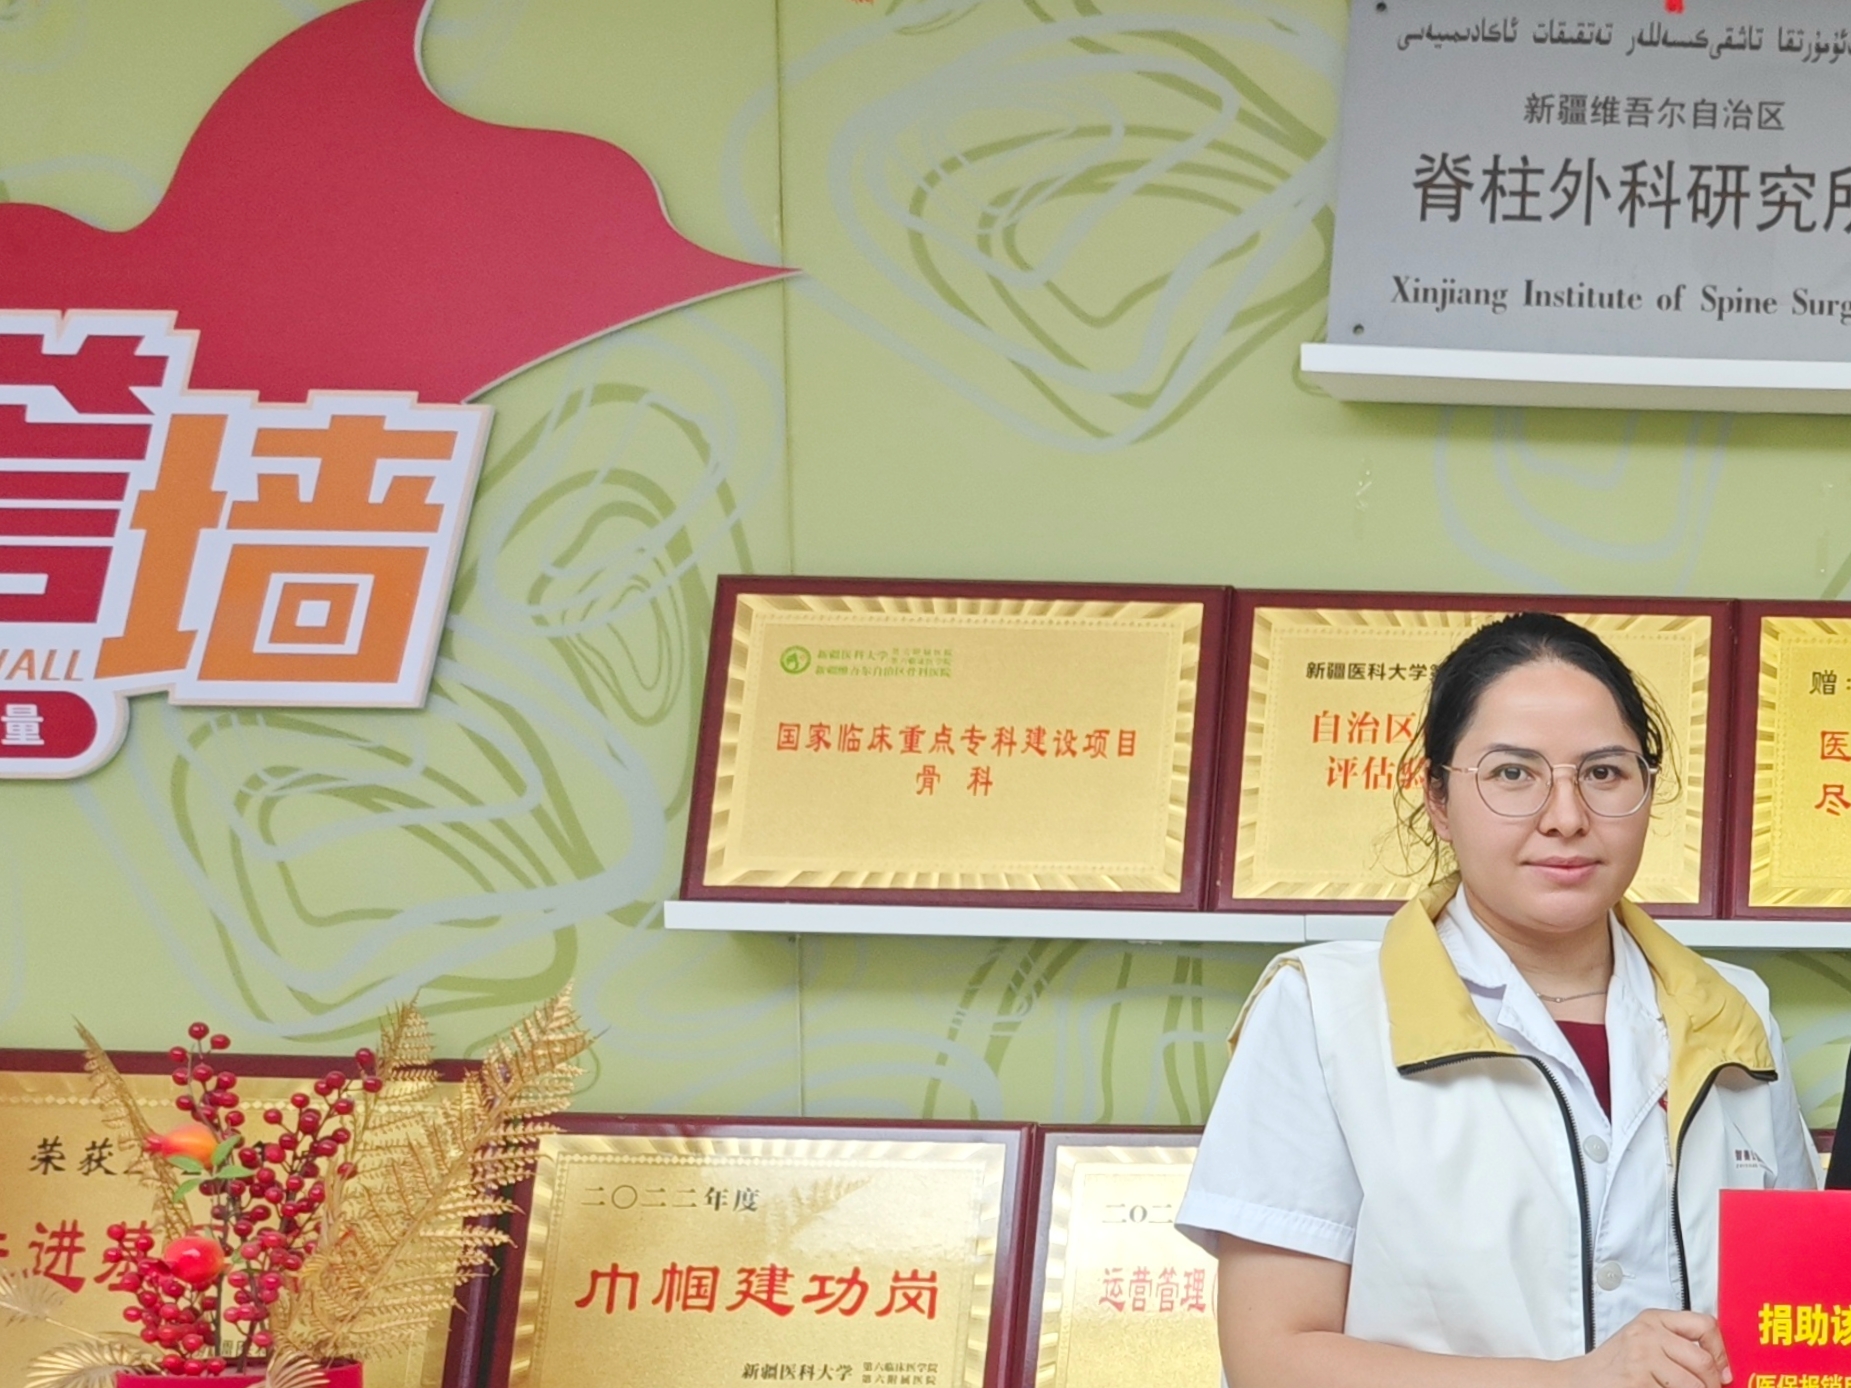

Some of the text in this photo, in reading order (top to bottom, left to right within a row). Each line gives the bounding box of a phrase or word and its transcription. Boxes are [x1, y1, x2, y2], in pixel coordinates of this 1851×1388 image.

[1523, 92, 1786, 131] 新疆维吾尔自治区
[1391, 276, 1508, 314] Xinjiang
[1523, 279, 1643, 310] Institute
[1656, 283, 1686, 312] of
[1700, 285, 1778, 318] Spine
[0, 648, 84, 681] ALL
[776, 722, 1138, 760] 国家临床重点专科建设项目
[1312, 710, 1416, 744] 自治区
[915, 764, 994, 797] 骨科
[574, 1262, 939, 1320] 巾帼建功岗
[1099, 1266, 1218, 1319] 运营管理
[742, 1362, 853, 1382] 新疆医科大学
